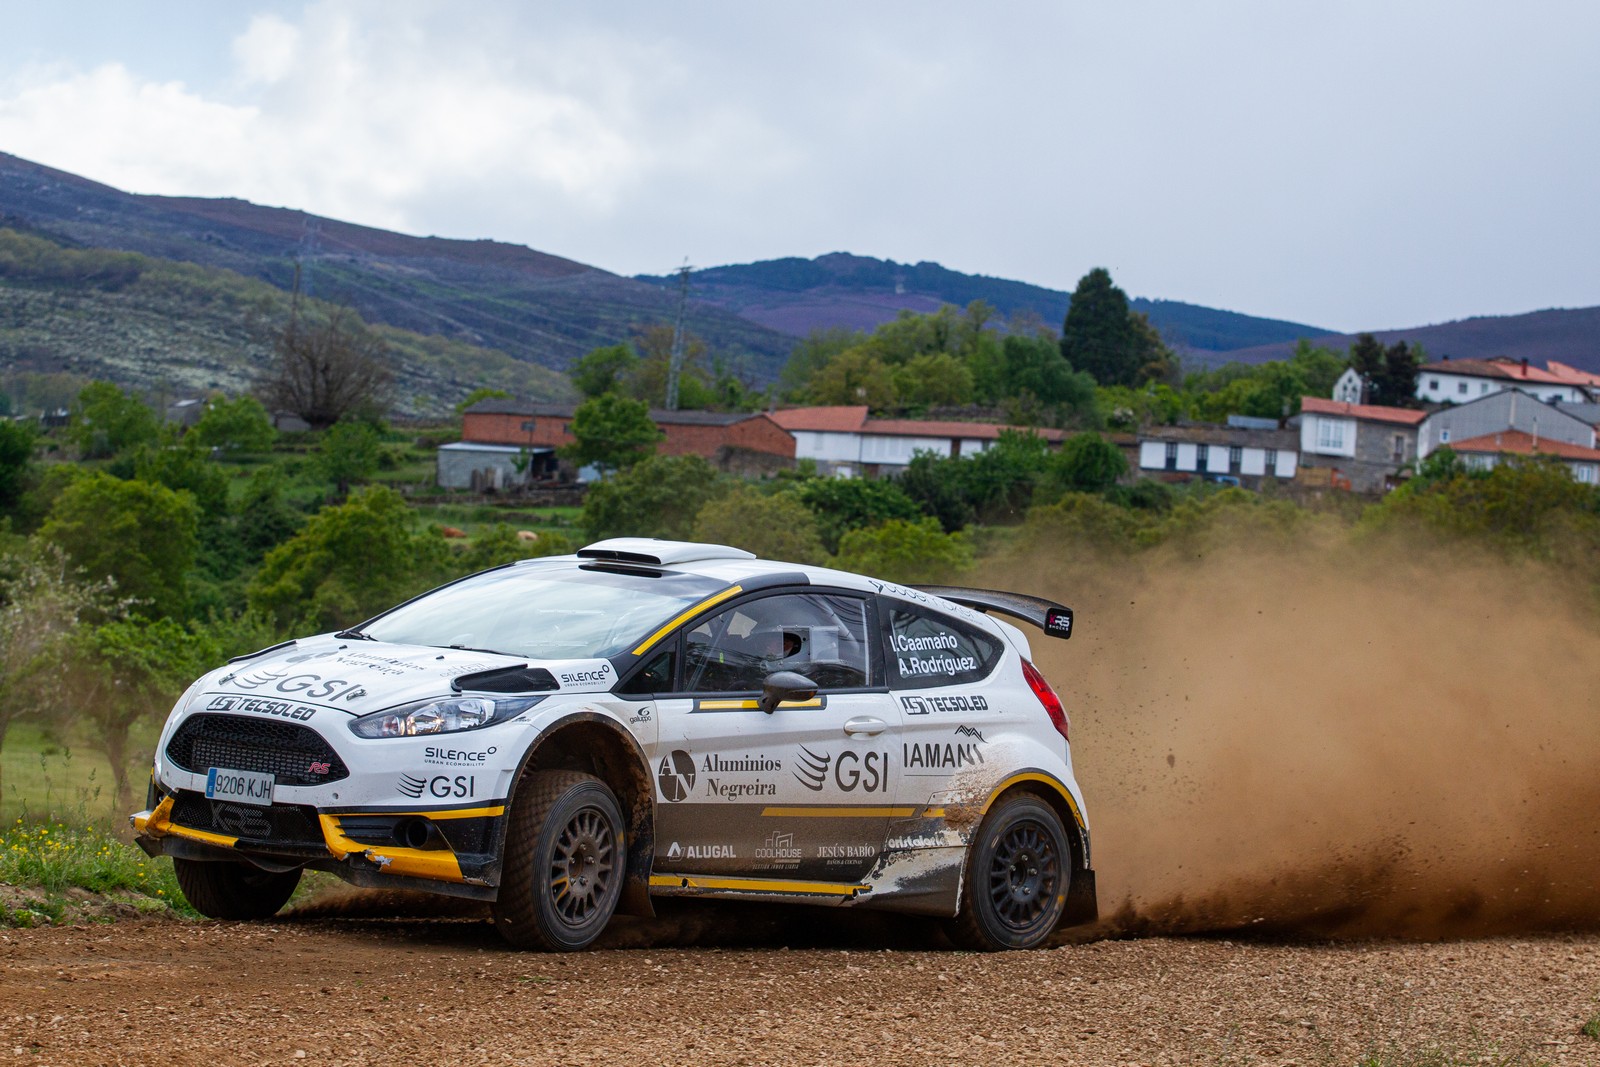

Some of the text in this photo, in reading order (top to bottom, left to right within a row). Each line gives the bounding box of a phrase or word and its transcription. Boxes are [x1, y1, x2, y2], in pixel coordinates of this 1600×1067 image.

[889, 632, 958, 652] I.Caamaño
[899, 654, 977, 676] A.Rodríguez
[275, 674, 361, 702] GSI
[238, 699, 316, 721] TECSOLED
[926, 695, 989, 712] TECSOLED
[308, 762, 331, 775] RS
[701, 753, 782, 773] Aluminios
[834, 750, 888, 793] GSI
[215, 775, 272, 800] 9206 KJH
[430, 775, 475, 798] GSI
[706, 778, 777, 802] Negreira
[686, 843, 737, 859] ALUGAL
[755, 848, 802, 858] COOLHOUSE
[817, 843, 875, 858] JESÚS BABÍO
